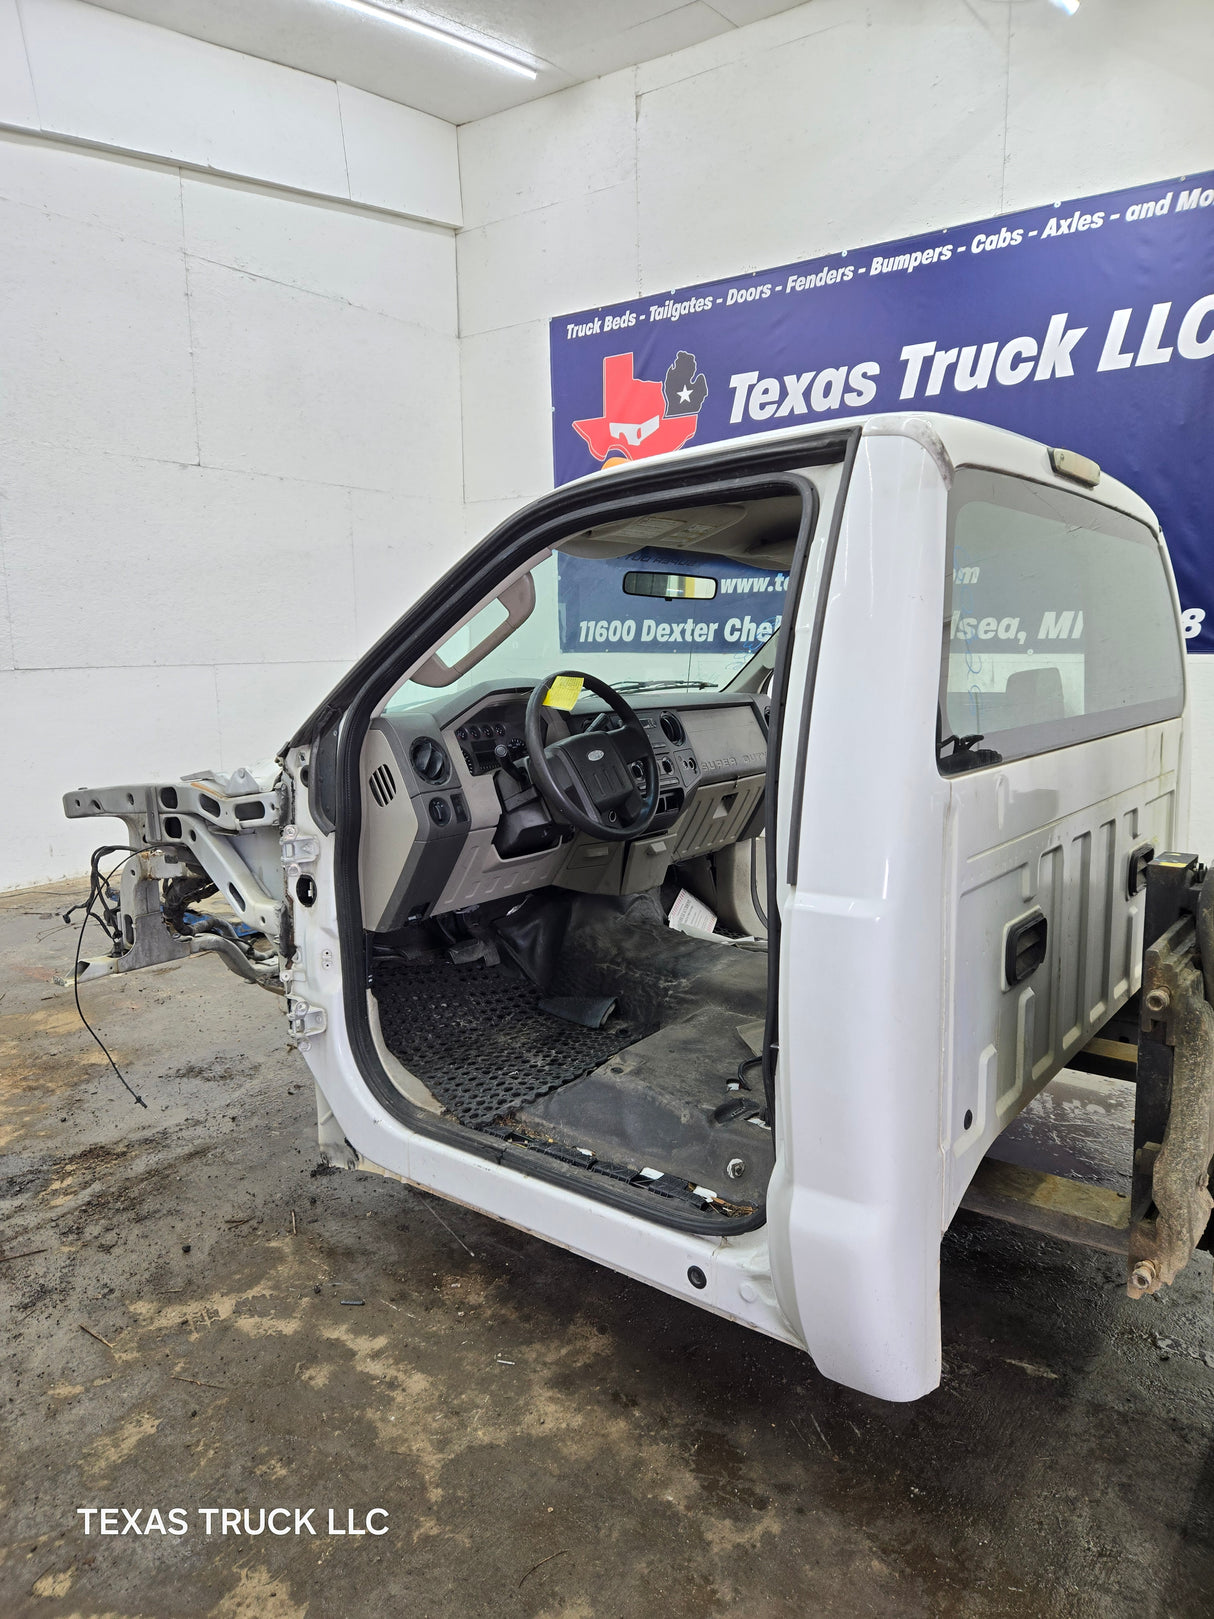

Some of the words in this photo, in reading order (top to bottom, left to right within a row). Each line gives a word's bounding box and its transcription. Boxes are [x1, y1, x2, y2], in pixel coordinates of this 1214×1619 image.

[567, 317, 602, 340] Truck
[604, 311, 637, 332] Beds
[650, 296, 713, 322] Tailgates
[726, 284, 771, 306] Doors
[786, 266, 855, 294] Fenders
[870, 245, 953, 276] Bumpers
[971, 227, 1024, 254] Cabs
[1041, 211, 1105, 240] Axles
[1125, 192, 1174, 222] and
[1175, 187, 1214, 213] Mo
[729, 362, 880, 424] Texas
[900, 313, 1089, 400] Truck
[1096, 293, 1214, 373] LLC
[579, 620, 637, 643] 11600
[641, 618, 719, 643] Dexter
